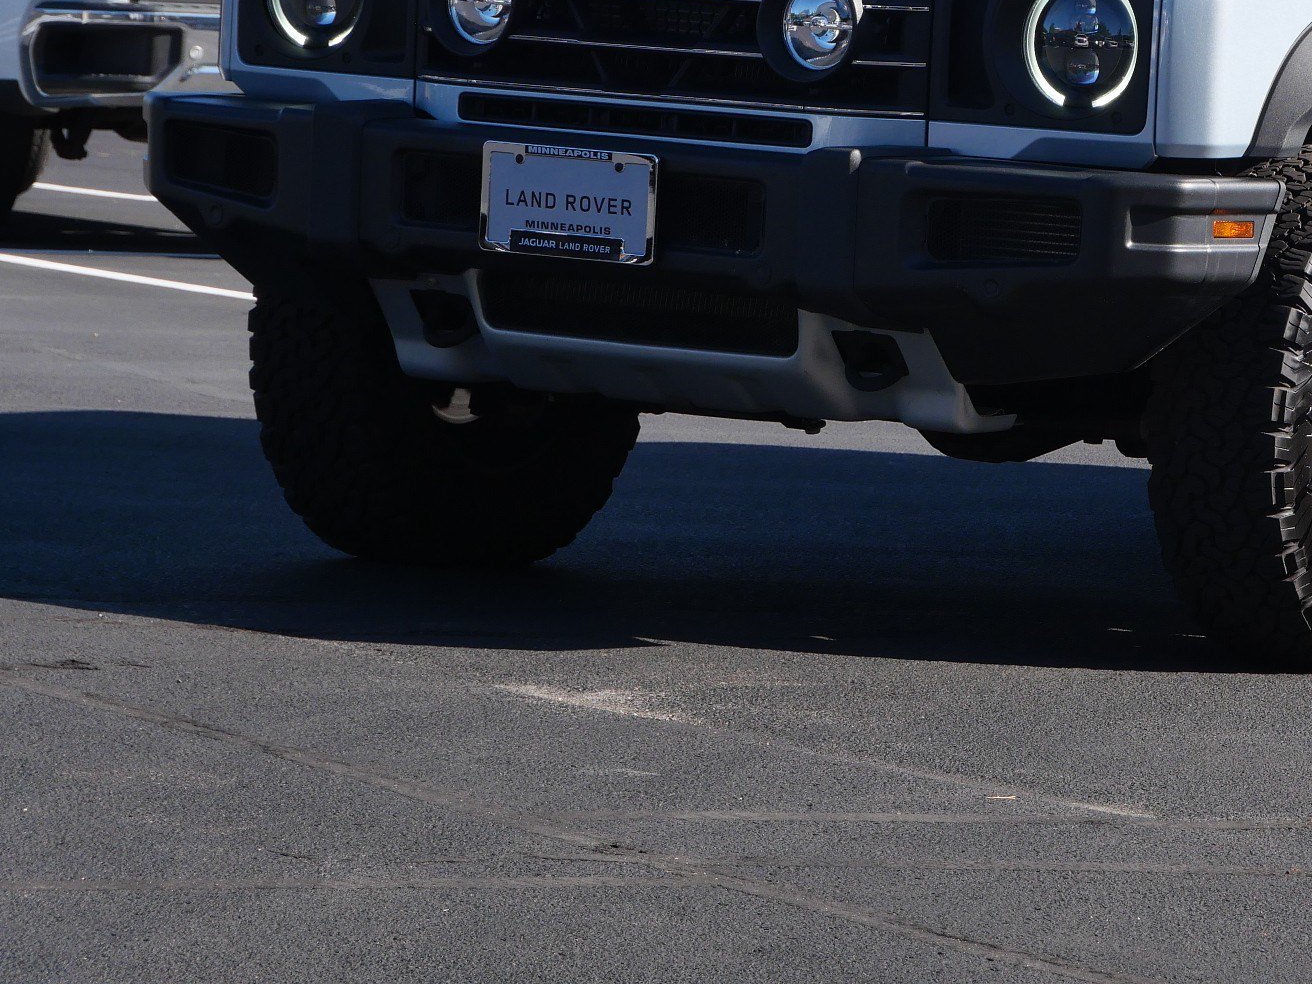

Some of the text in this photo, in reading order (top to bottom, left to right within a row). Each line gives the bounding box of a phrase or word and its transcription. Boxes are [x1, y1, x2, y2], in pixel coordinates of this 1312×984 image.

[528, 145, 609, 160] MINNEAPOLIS
[505, 188, 632, 216] LAND ROVER
[525, 219, 611, 235] MINNEAPOLIS
[518, 237, 611, 254] JAGUAR LAND ROVER
